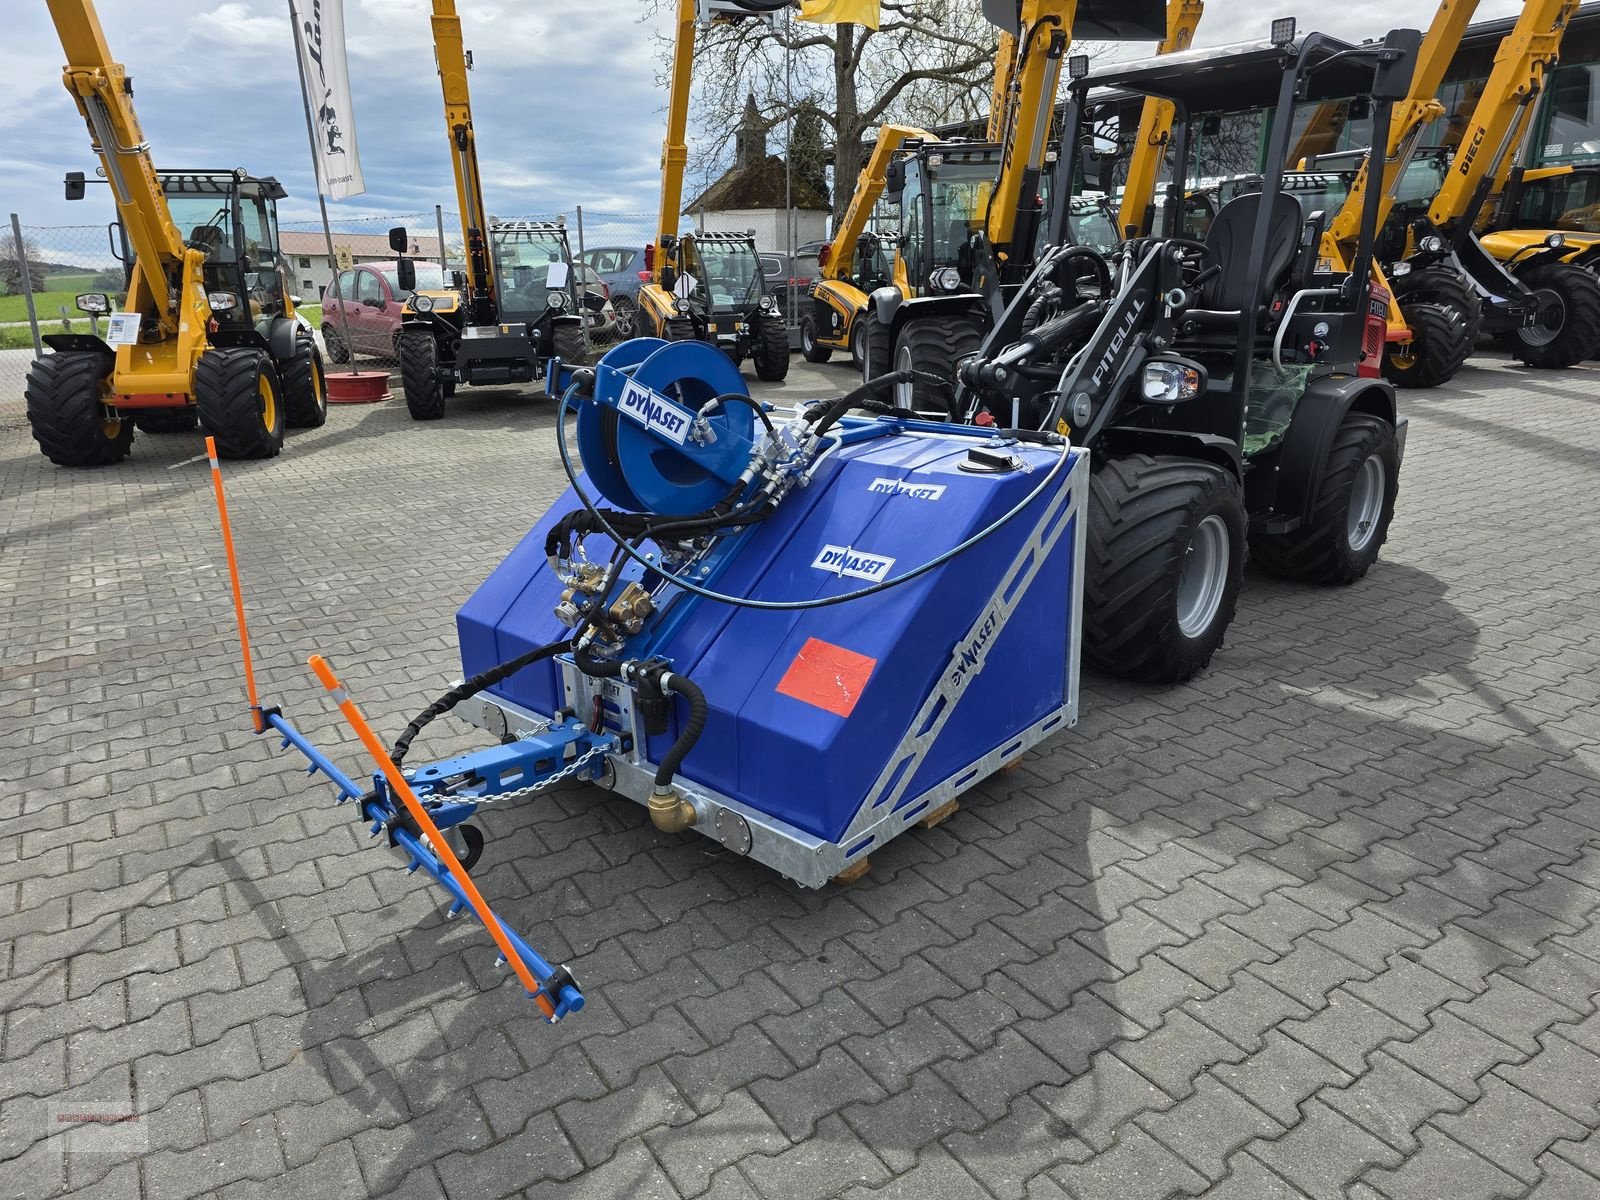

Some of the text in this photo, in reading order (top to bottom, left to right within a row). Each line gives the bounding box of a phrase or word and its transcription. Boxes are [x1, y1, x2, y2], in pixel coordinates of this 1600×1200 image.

[1460, 125, 1486, 176] DIECI
[1091, 299, 1145, 387] PITBULL
[625, 389, 686, 434] DYNASET
[819, 547, 887, 575] DYNASET
